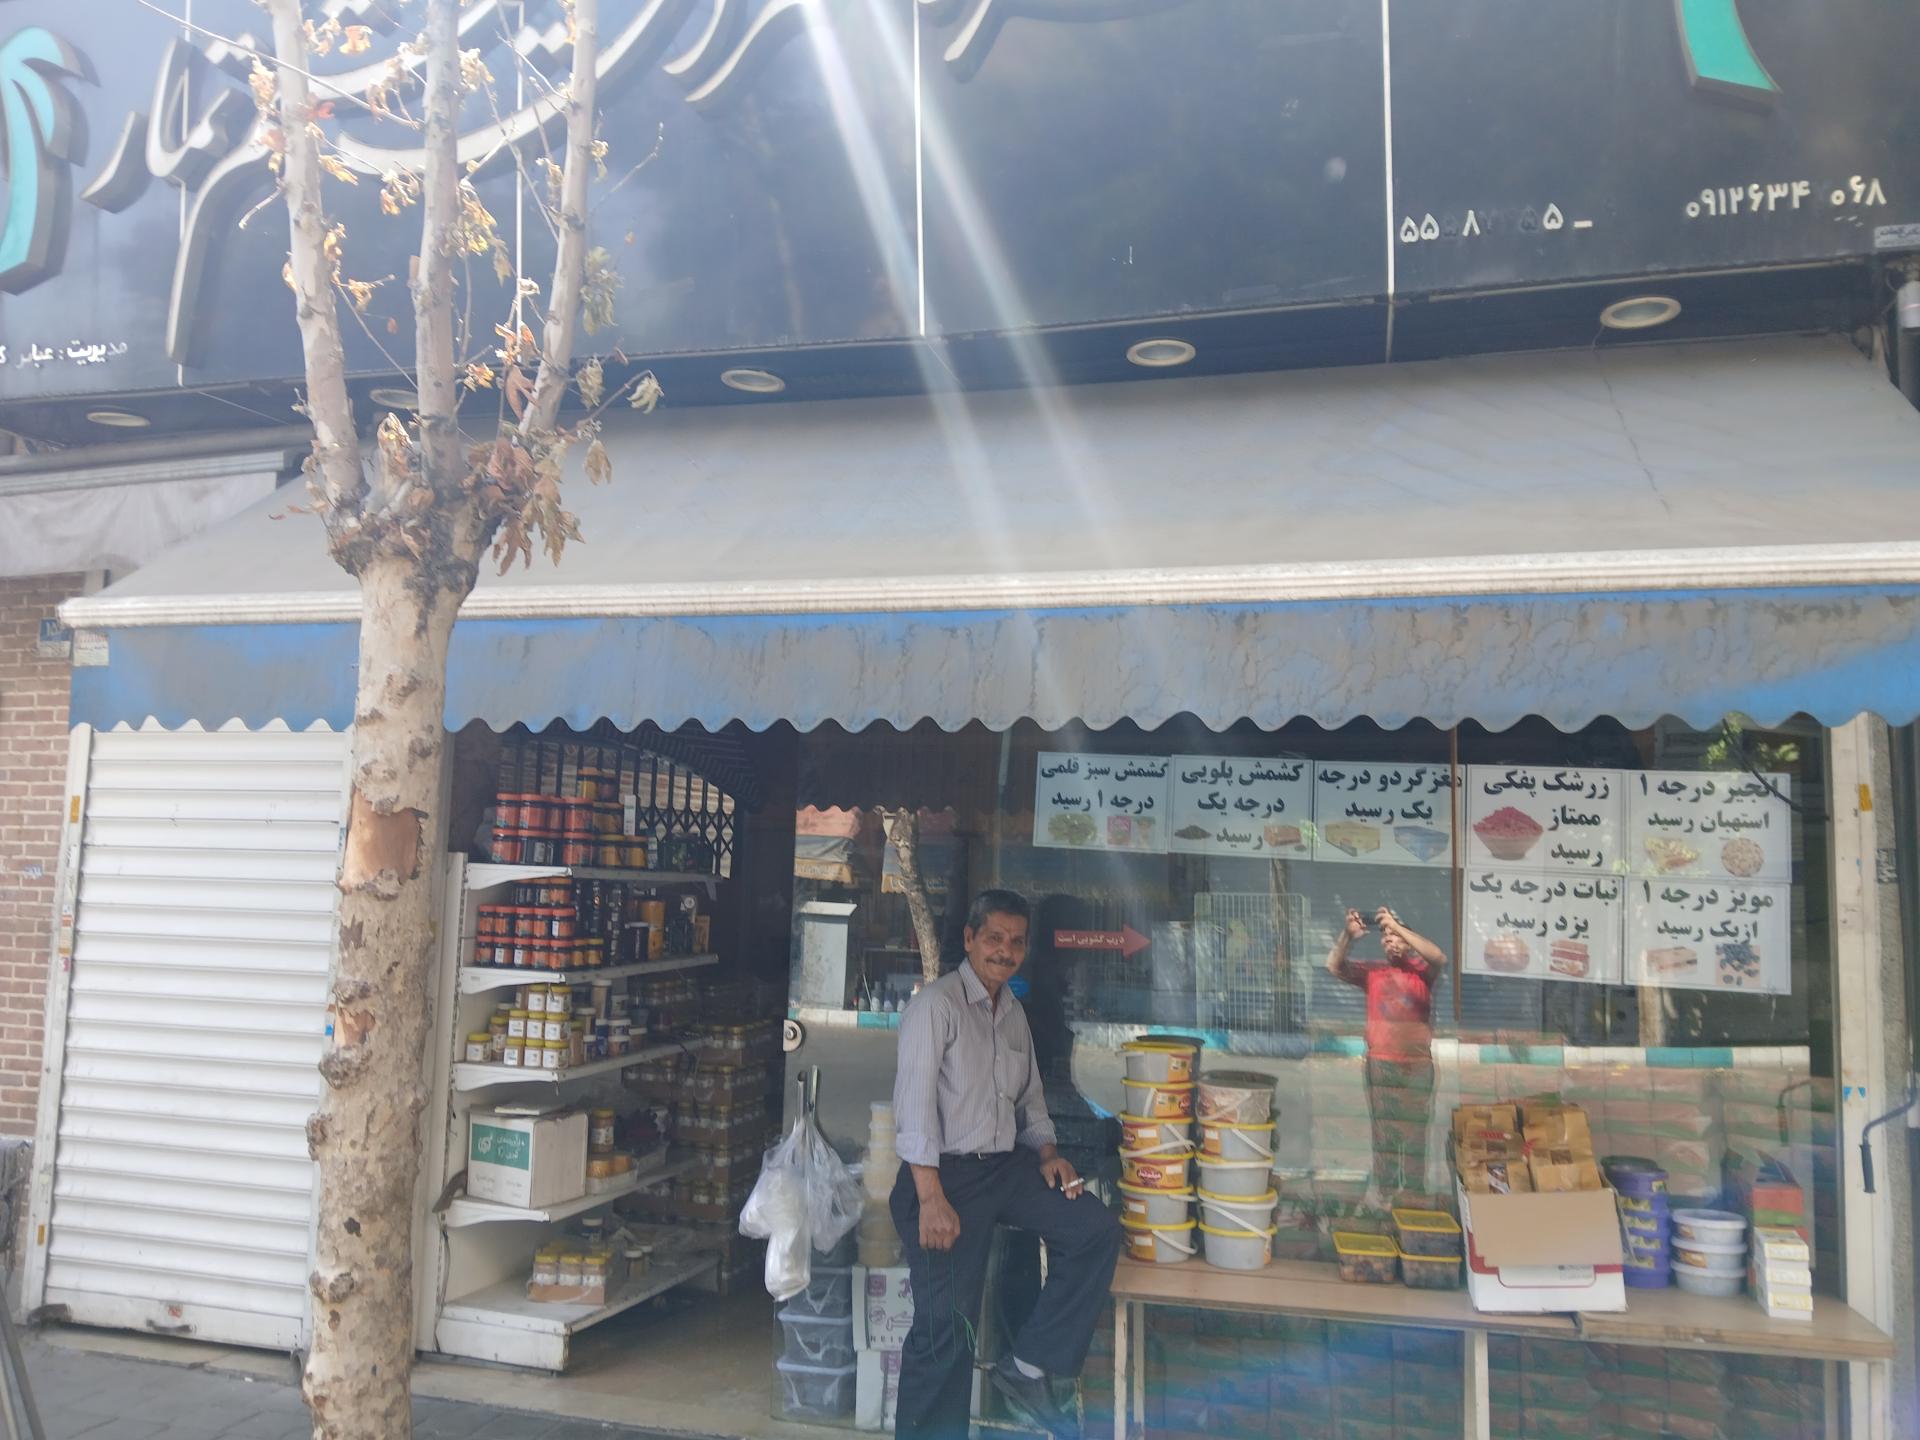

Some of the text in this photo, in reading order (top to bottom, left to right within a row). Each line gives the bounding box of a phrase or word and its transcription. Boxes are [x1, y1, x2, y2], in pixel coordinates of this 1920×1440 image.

[1041, 756, 1169, 781] کشمش سبز قلمی
[1181, 759, 1304, 786] کشمش پلویی
[1318, 766, 1371, 791] درجه
[1377, 766, 1428, 793] گردو
[1483, 769, 1610, 799] زرشک پفکی
[1657, 779, 1716, 803] درجه
[1052, 791, 1091, 812] رسید
[1110, 794, 1155, 814] درجه
[1197, 792, 1285, 818] درجه یک
[1345, 800, 1433, 825] یک رسید
[1548, 804, 1601, 831] ممتاز
[1648, 809, 1770, 833] استهبان رسید
[1216, 827, 1264, 850] رسید
[1551, 843, 1603, 867] رسید
[1470, 872, 1618, 906] نبات درجه یک
[1660, 887, 1719, 911] درجه
[1726, 889, 1774, 914] مویز
[1496, 911, 1590, 939] یزد رسید
[1657, 920, 1758, 944] ازبک رسید
